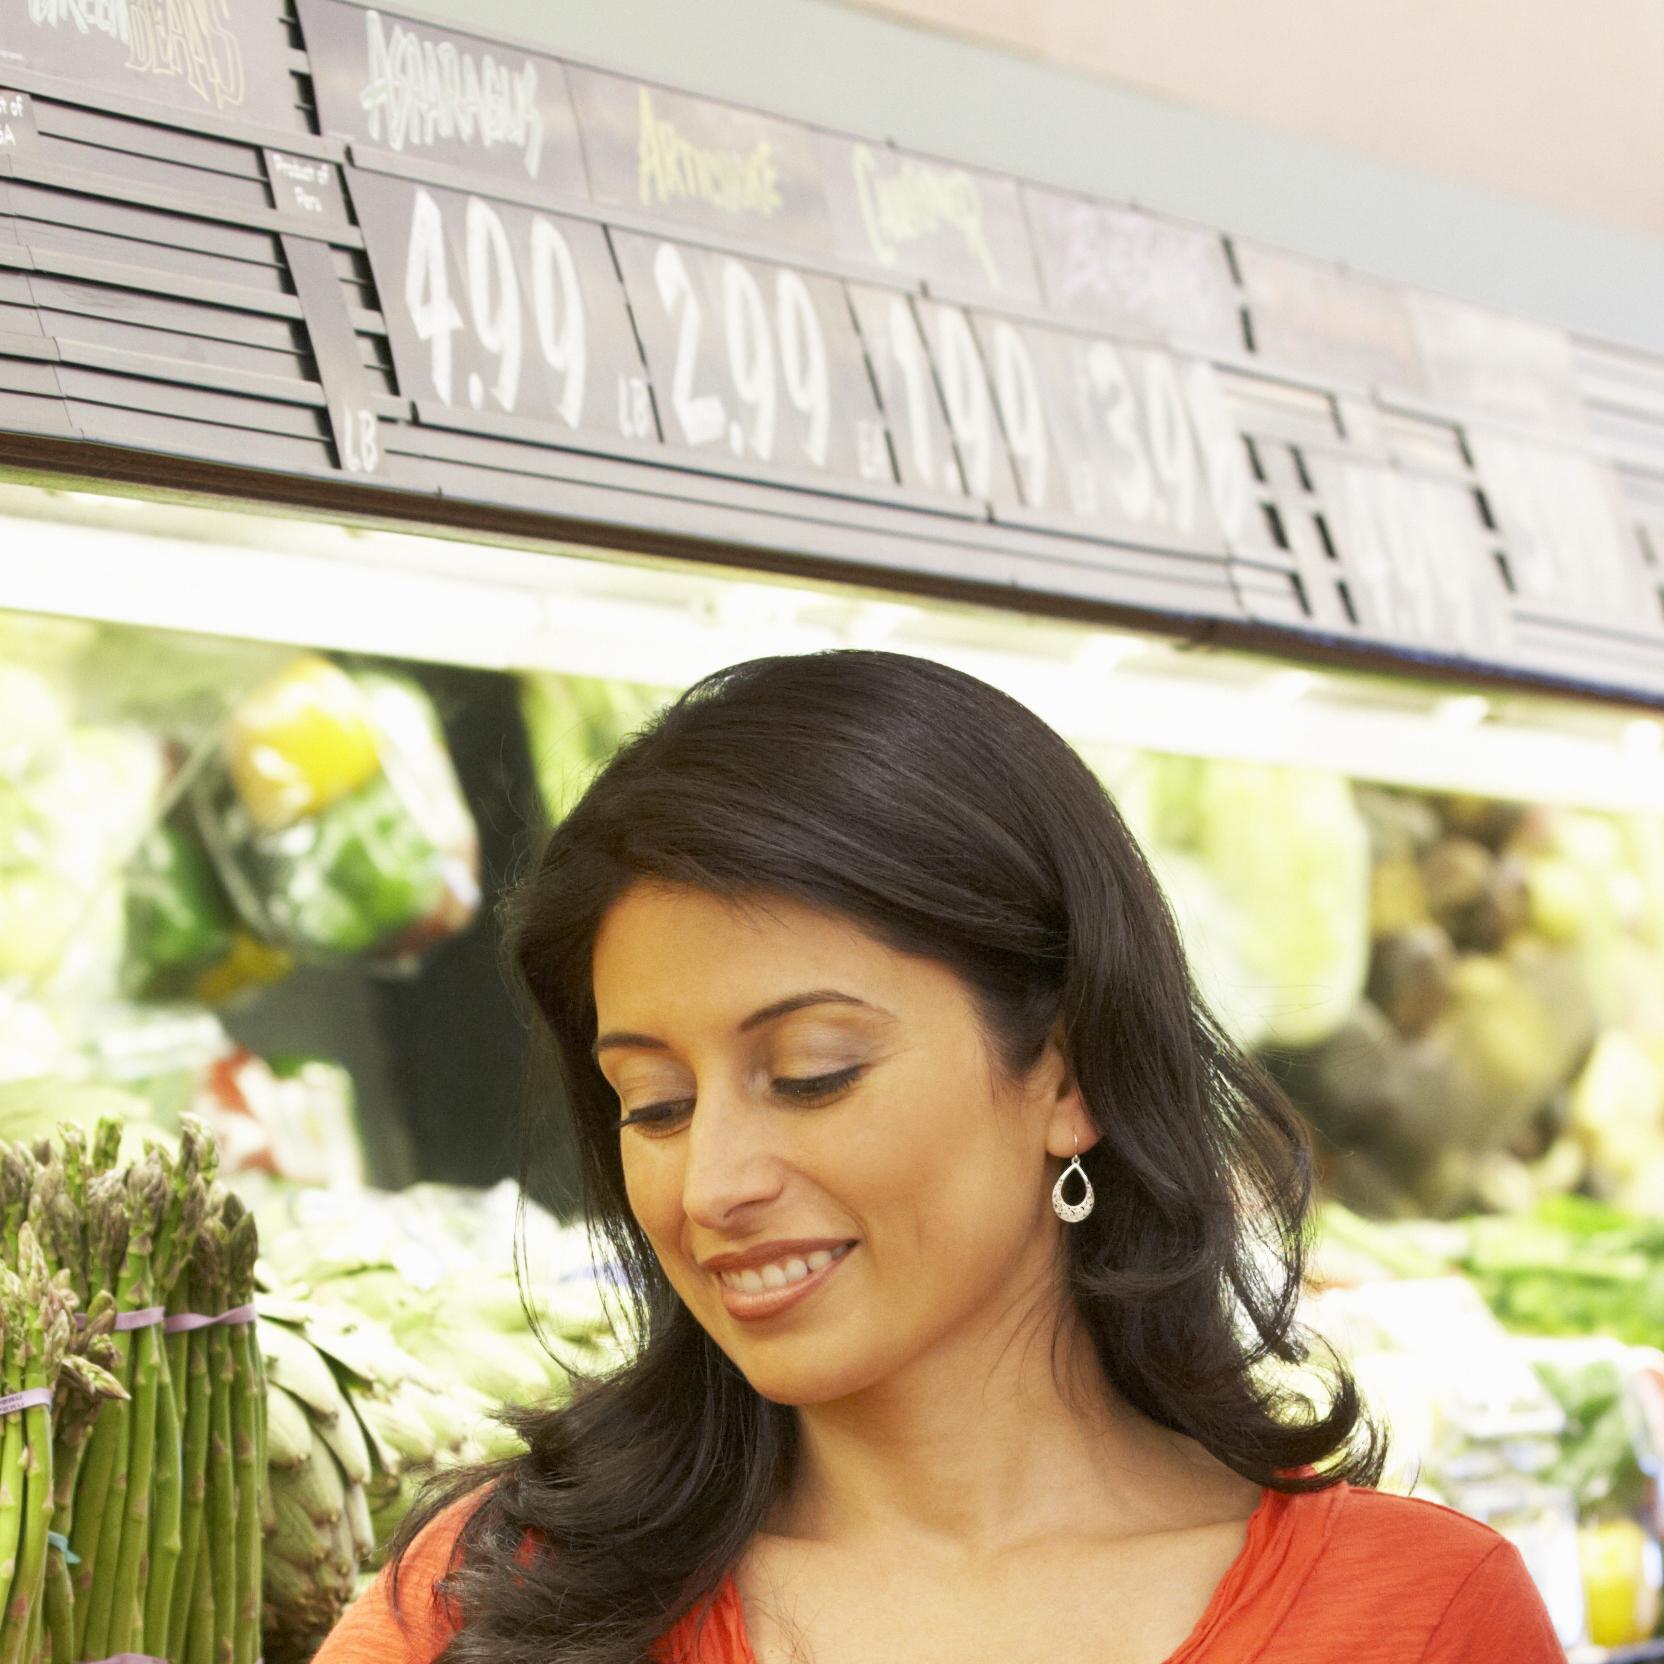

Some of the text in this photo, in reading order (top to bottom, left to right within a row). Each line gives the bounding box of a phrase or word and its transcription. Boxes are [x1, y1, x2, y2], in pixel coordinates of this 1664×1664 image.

[10, 93, 24, 117] of
[405, 186, 586, 430] 4.99
[654, 242, 826, 469] 2.99
[343, 405, 378, 474] LB
